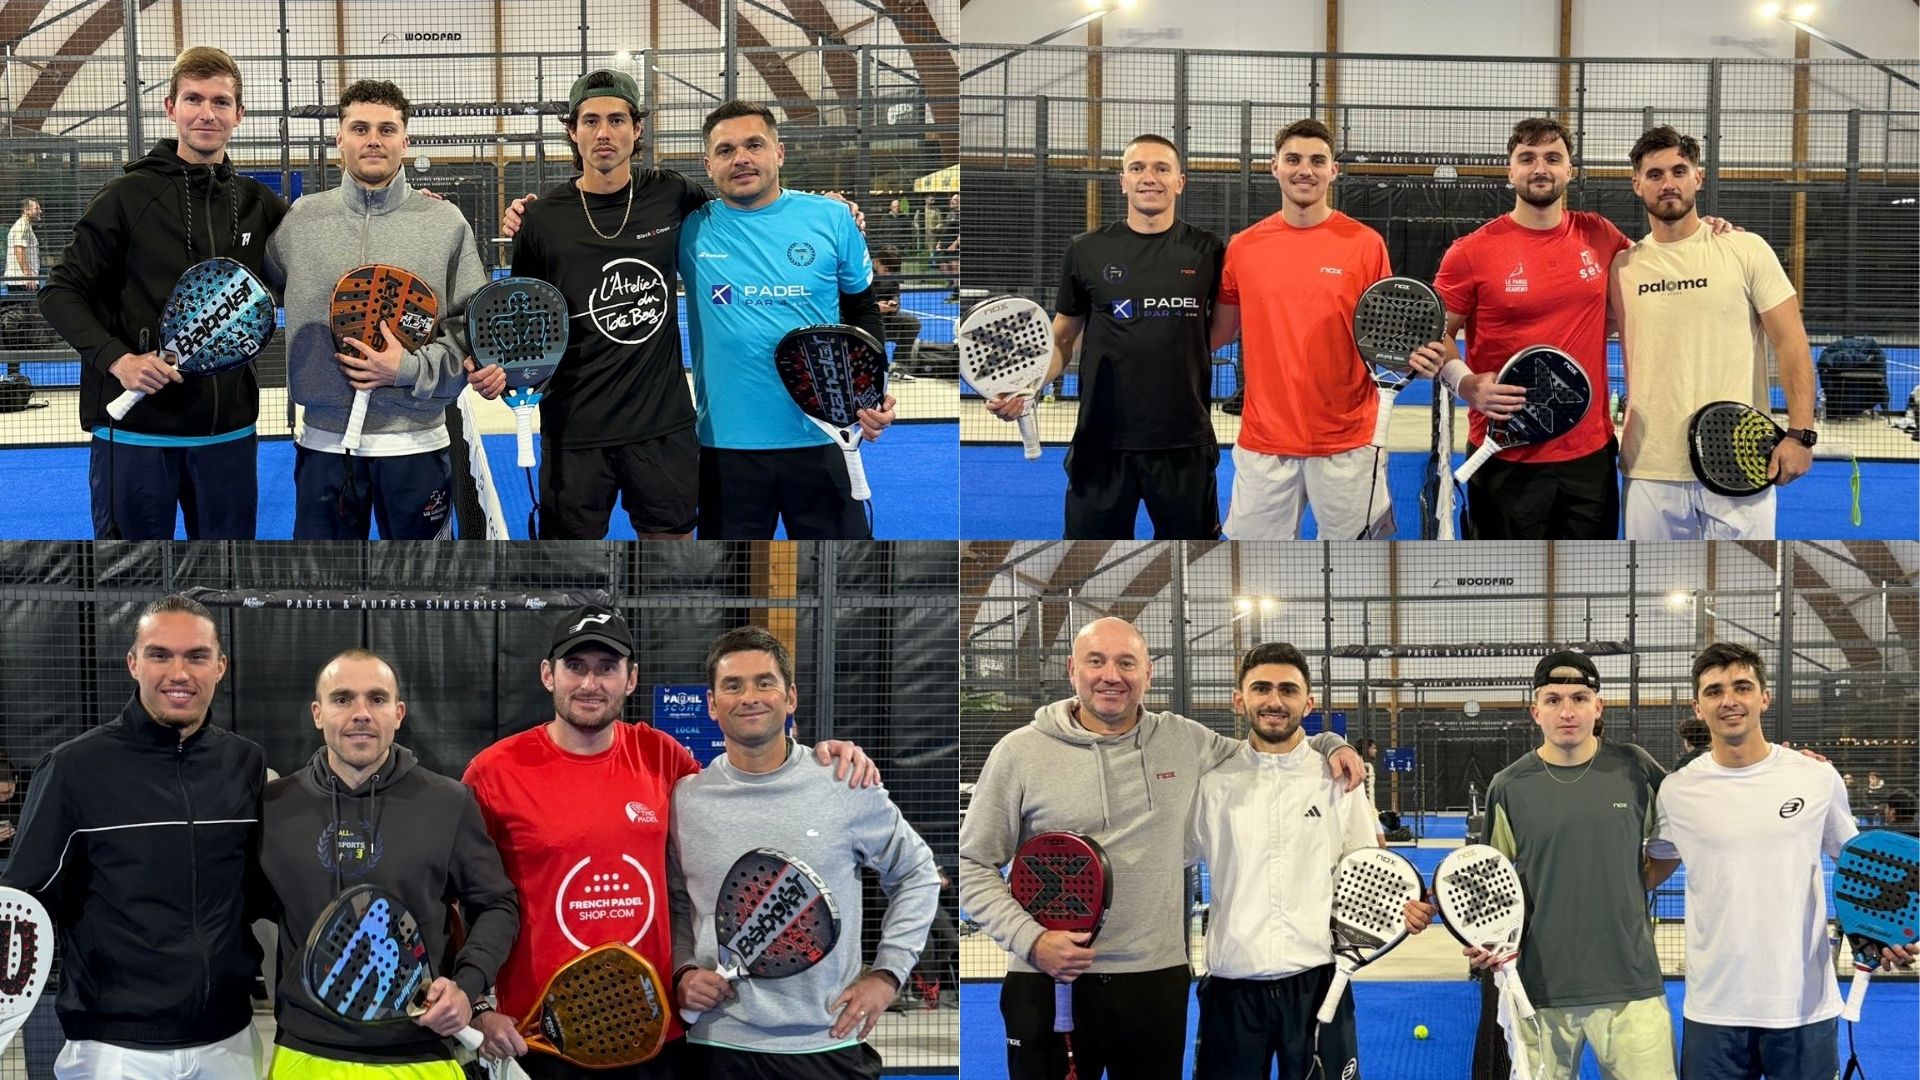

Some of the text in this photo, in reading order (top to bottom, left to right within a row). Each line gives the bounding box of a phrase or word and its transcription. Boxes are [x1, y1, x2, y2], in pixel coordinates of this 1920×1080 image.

[405, 32, 462, 42] WOODPAD
[415, 107, 513, 116] AUTRES SINGERIES
[1464, 157, 1509, 165] SINGERIE
[600, 271, 661, 301] L'Atelier
[744, 285, 812, 297] PADEL
[1638, 277, 1708, 296] paloma
[637, 291, 661, 307] du
[745, 299, 773, 307] PAR
[1143, 297, 1200, 309] PADEL
[598, 307, 664, 332] Tote Bag
[1144, 310, 1170, 318] PAR
[1456, 577, 1514, 586] WOODPAD
[286, 599, 507, 610] PADEL & AUTRES SINGERIES
[663, 693, 702, 704] PADEL
[663, 704, 701, 712] SCORE
[675, 726, 701, 734] LOCAL
[337, 841, 366, 849] SPORTS
[569, 897, 644, 910] FRENCH PADEL
[578, 908, 635, 921] SHOP.COM
